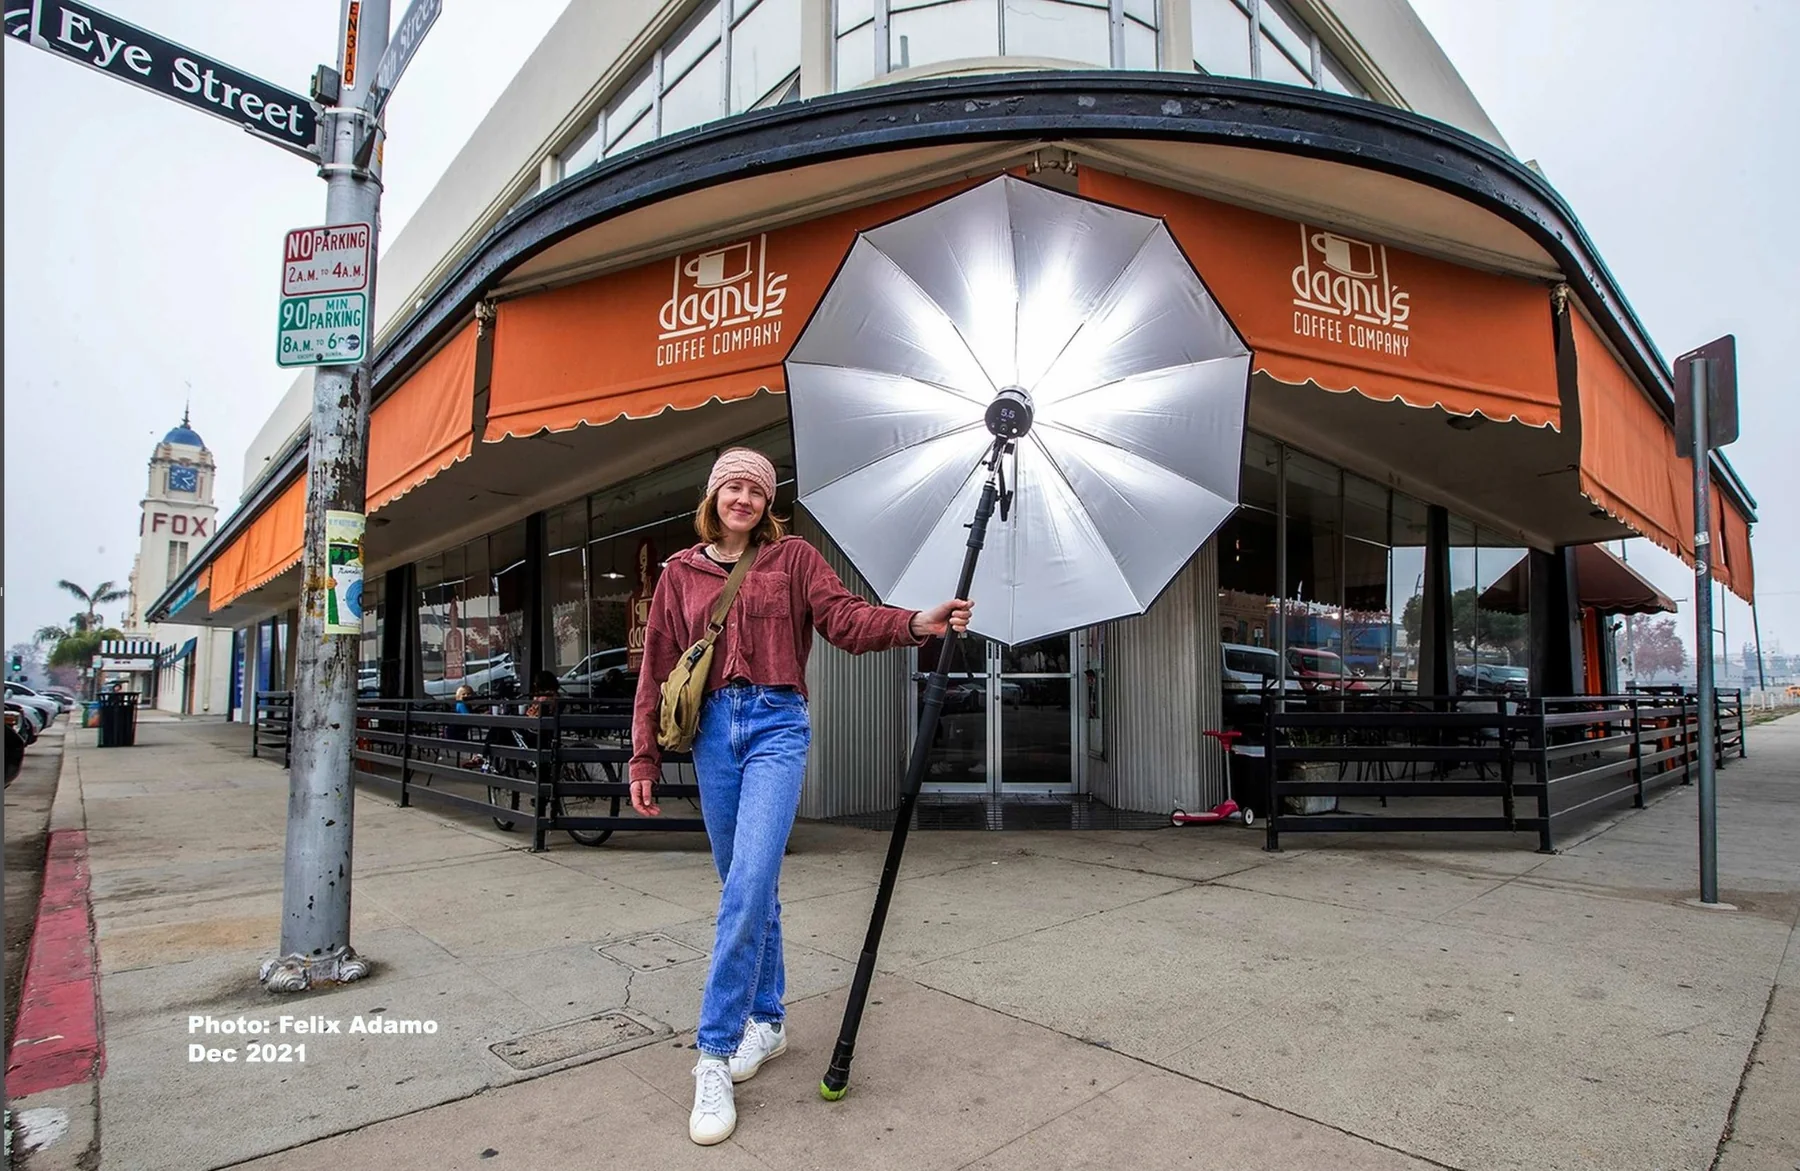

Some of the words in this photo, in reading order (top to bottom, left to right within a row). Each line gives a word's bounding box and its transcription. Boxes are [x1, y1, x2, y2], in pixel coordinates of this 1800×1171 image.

[57, 6, 153, 76] Eye
[172, 57, 304, 136] Street
[288, 231, 311, 259] NO
[314, 231, 366, 252] PARKING
[288, 266, 318, 283] 2A.M.
[332, 261, 365, 278] 4A.M.
[659, 233, 788, 331] dagny's
[1292, 223, 1410, 326] dagny's
[283, 302, 308, 329] 90
[309, 310, 361, 330] PARKING
[1293, 311, 1343, 343] COFFEE
[1348, 324, 1409, 357] COMPANY
[656, 337, 706, 367] COFFEE
[713, 321, 782, 355] COMPANY
[152, 512, 208, 537] FOX
